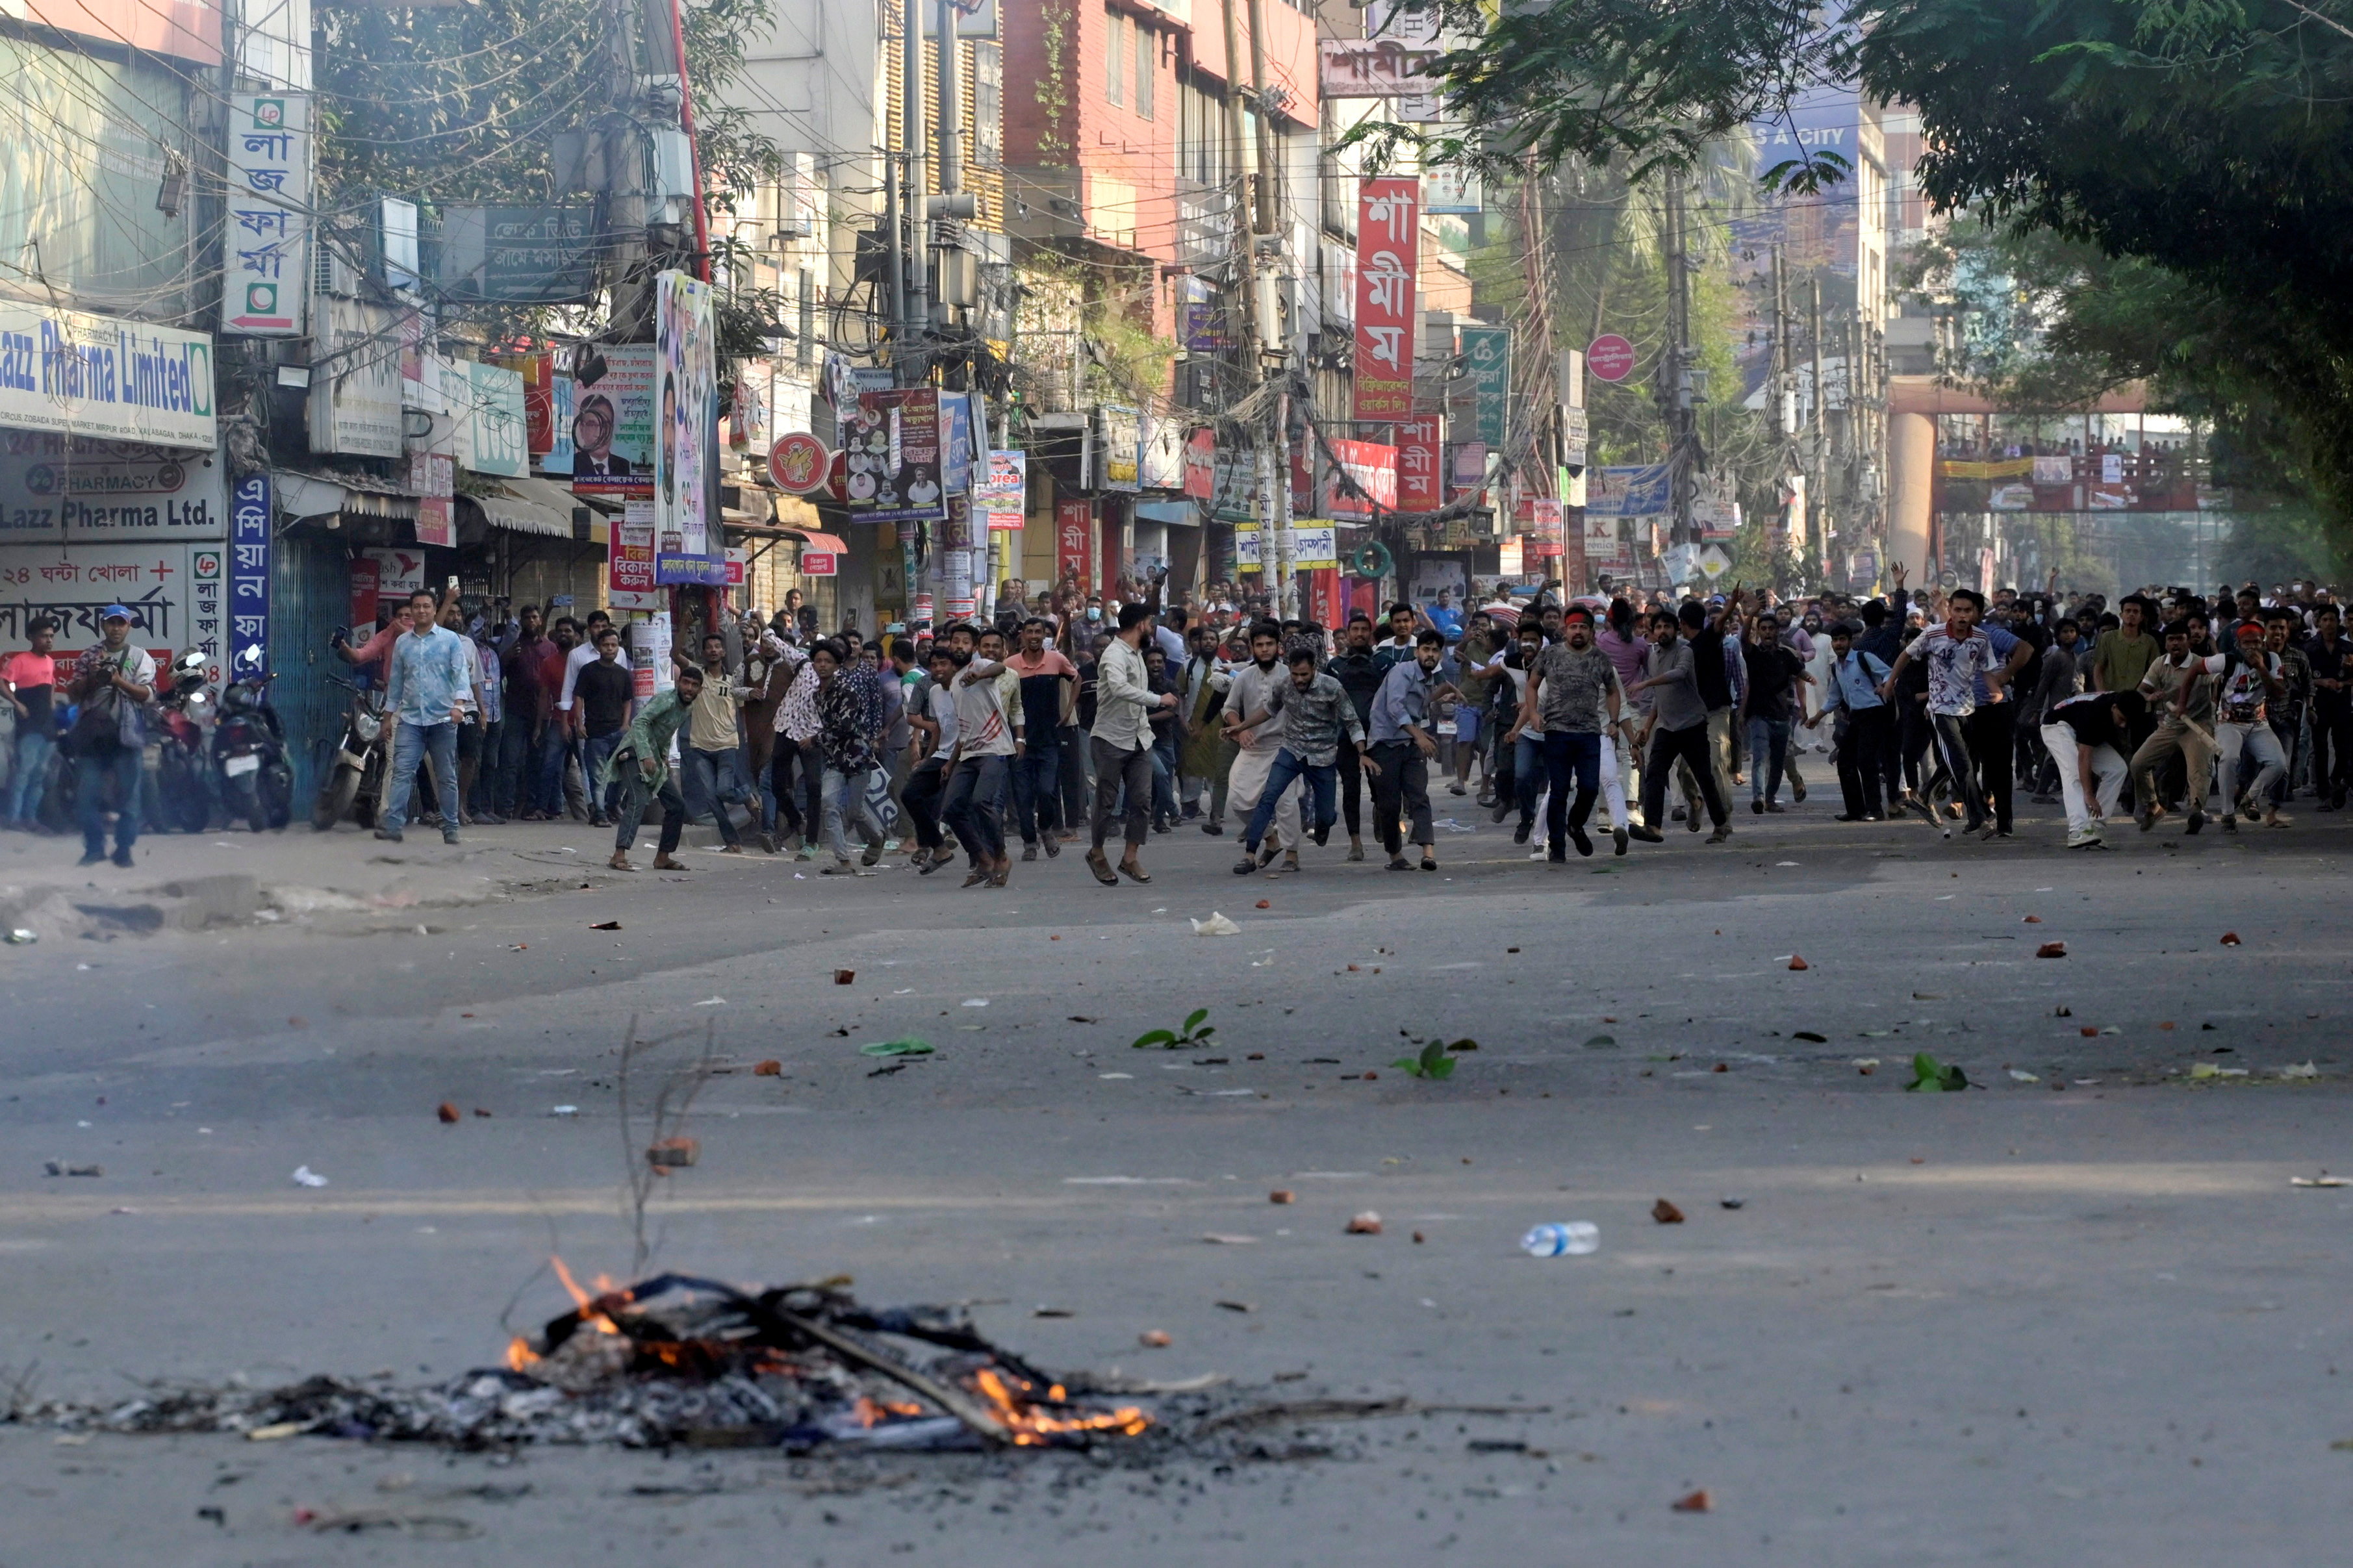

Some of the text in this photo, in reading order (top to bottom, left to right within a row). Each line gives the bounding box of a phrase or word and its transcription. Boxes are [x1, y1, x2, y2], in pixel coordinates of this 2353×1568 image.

[1798, 127, 1845, 145] CITY
[1362, 188, 1414, 373] শামীম
[0, 319, 191, 412] azz Pharma Limited
[1357, 376, 1410, 393] রিফ্রিজারেশন
[1, 412, 23, 423] CIRCUS,
[24, 414, 50, 425] ZOBAIDA
[71, 420, 95, 431] MARKET,
[95, 423, 118, 435] MIRPUR
[120, 425, 138, 436] ROAD,
[178, 432, 198, 440] DHAKA
[1399, 422, 1434, 494] শামীম
[58, 475, 155, 490] PHARMACY
[990, 474, 1019, 484] orea
[0, 499, 214, 529] Lazz Pharma Ltd.
[1061, 503, 1087, 572] শামীম
[1239, 533, 1261, 560] শামী
[625, 544, 650, 561] বিল
[3, 562, 140, 586] ২৪ ঘন্টা খোলা
[615, 557, 655, 575] বিকাশ
[620, 574, 649, 587] করুন
